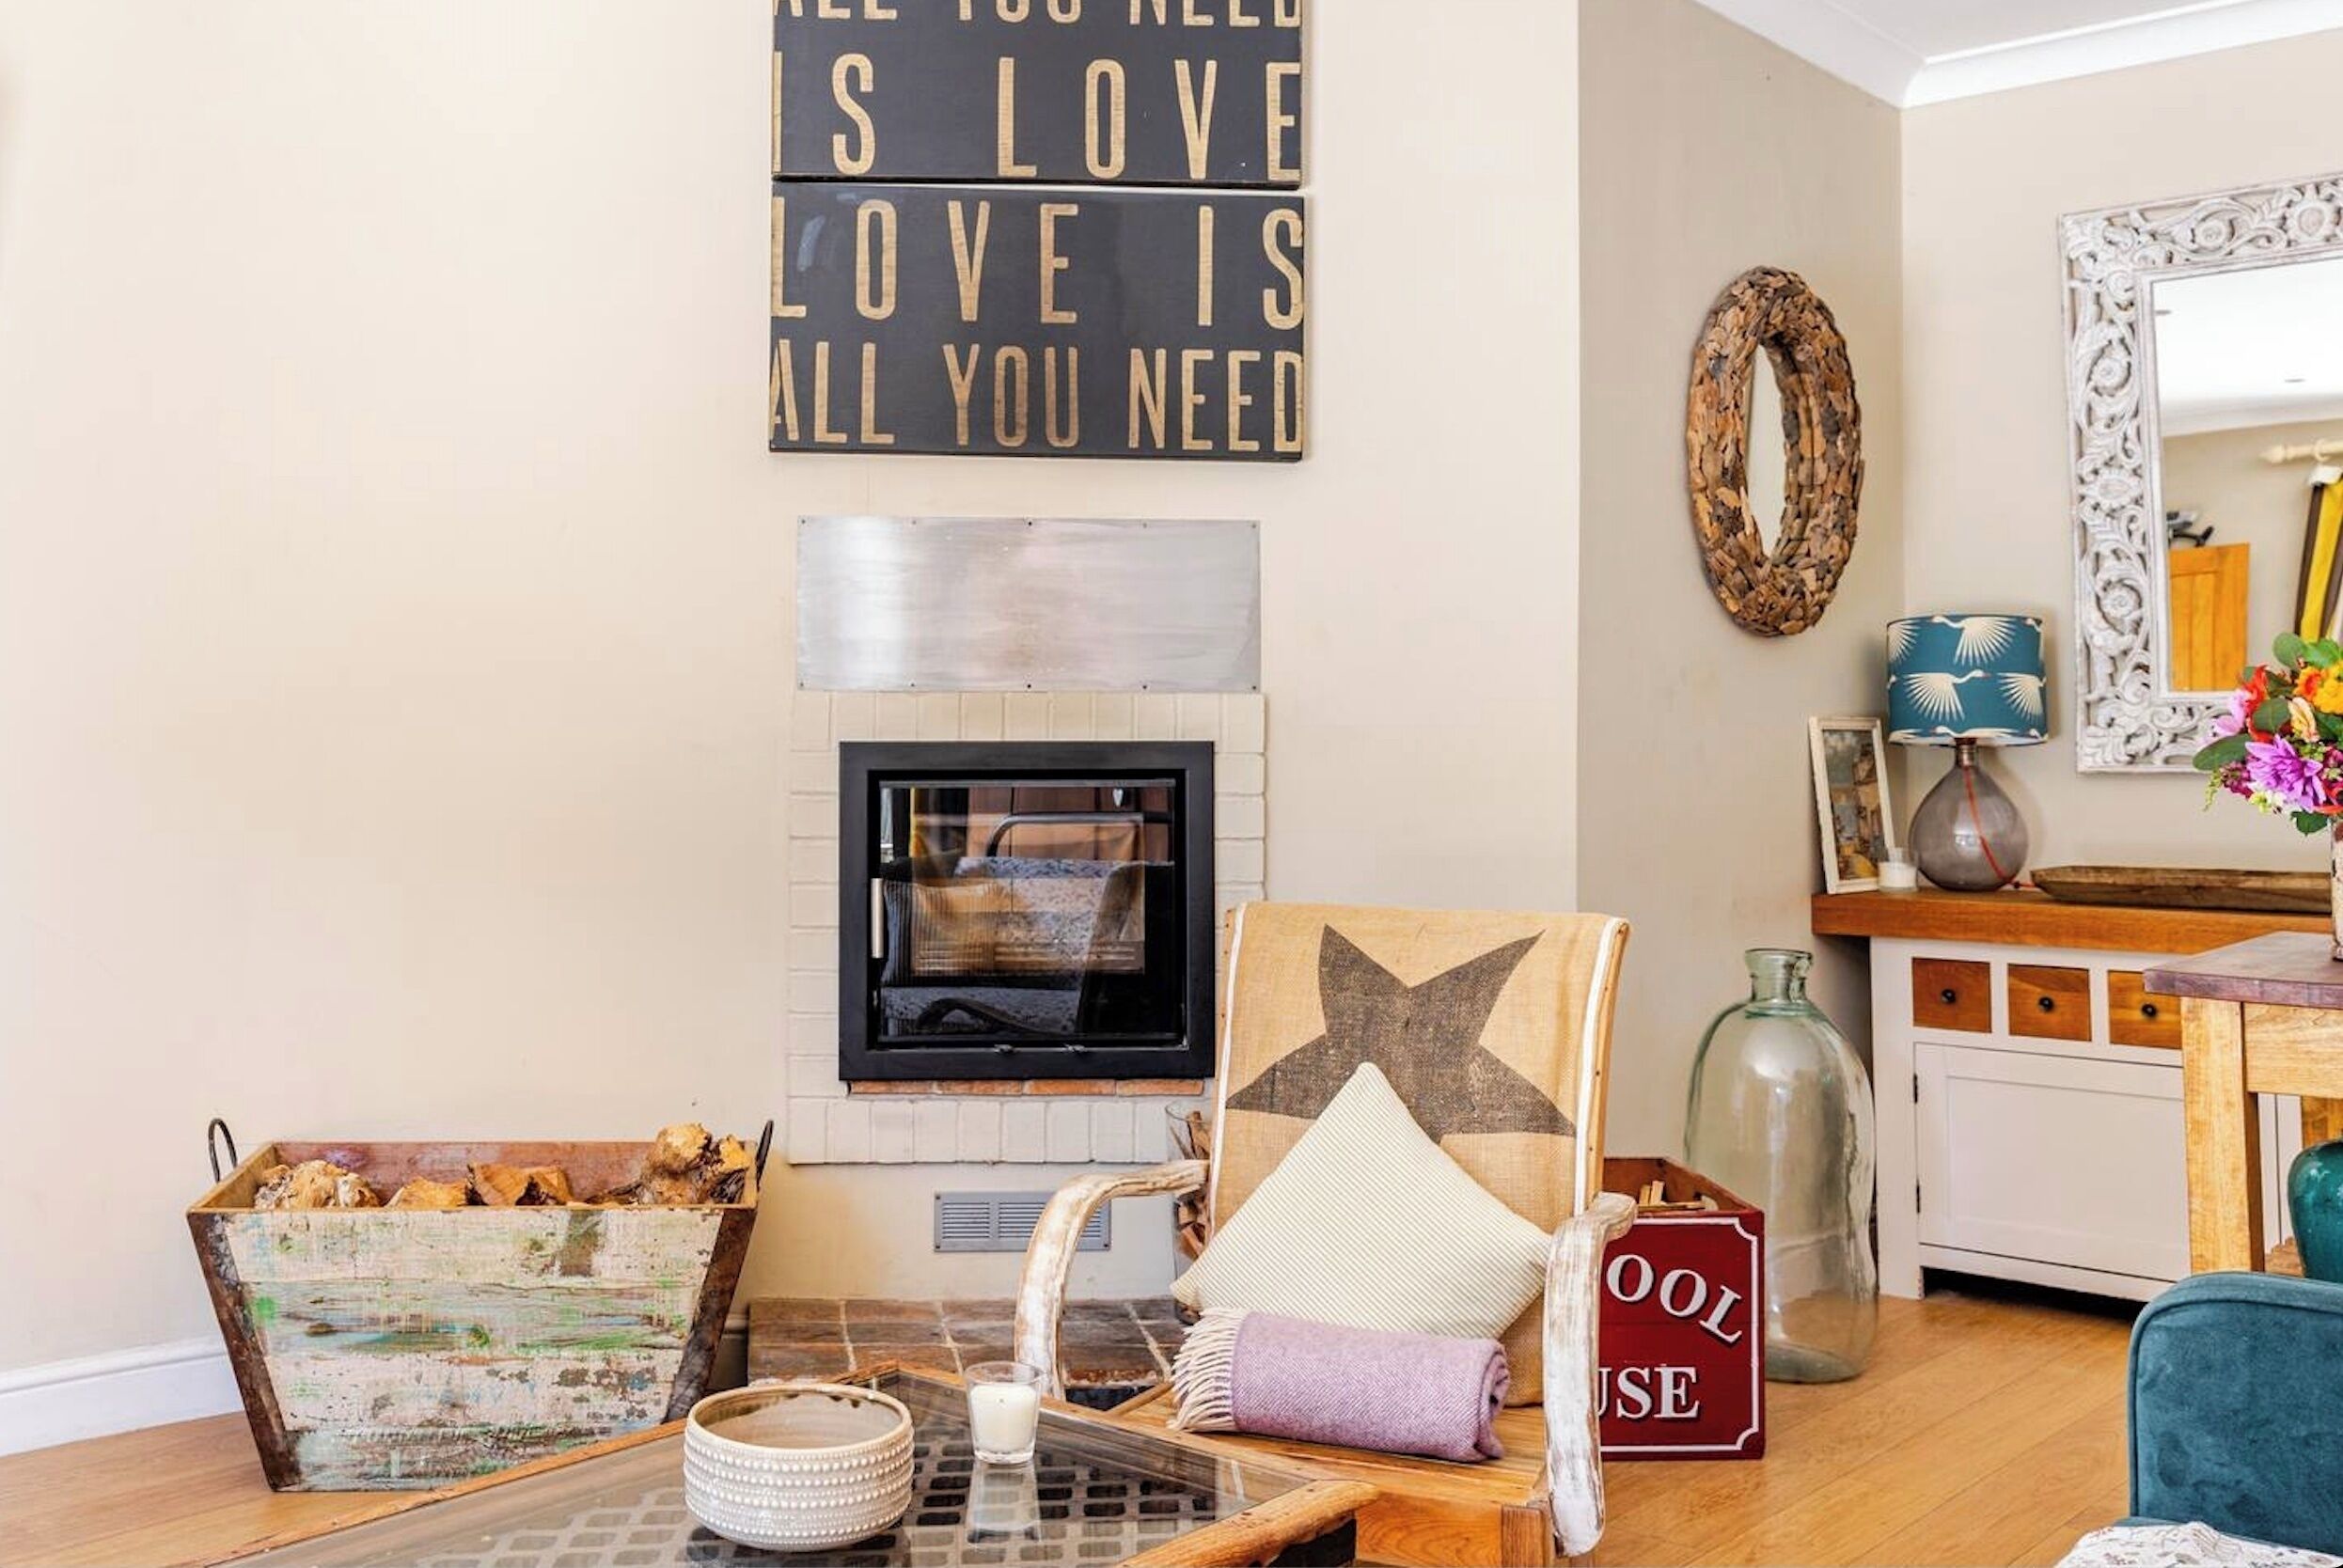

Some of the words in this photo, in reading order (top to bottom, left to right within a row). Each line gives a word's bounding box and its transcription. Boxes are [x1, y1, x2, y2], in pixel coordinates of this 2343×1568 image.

[998, 56, 1301, 180] LOVE
[771, 196, 1078, 323] LOVE
[1197, 204, 1303, 330] IS
[770, 338, 895, 444] ALL
[942, 342, 1078, 447] YOU
[1128, 347, 1303, 452] NEED
